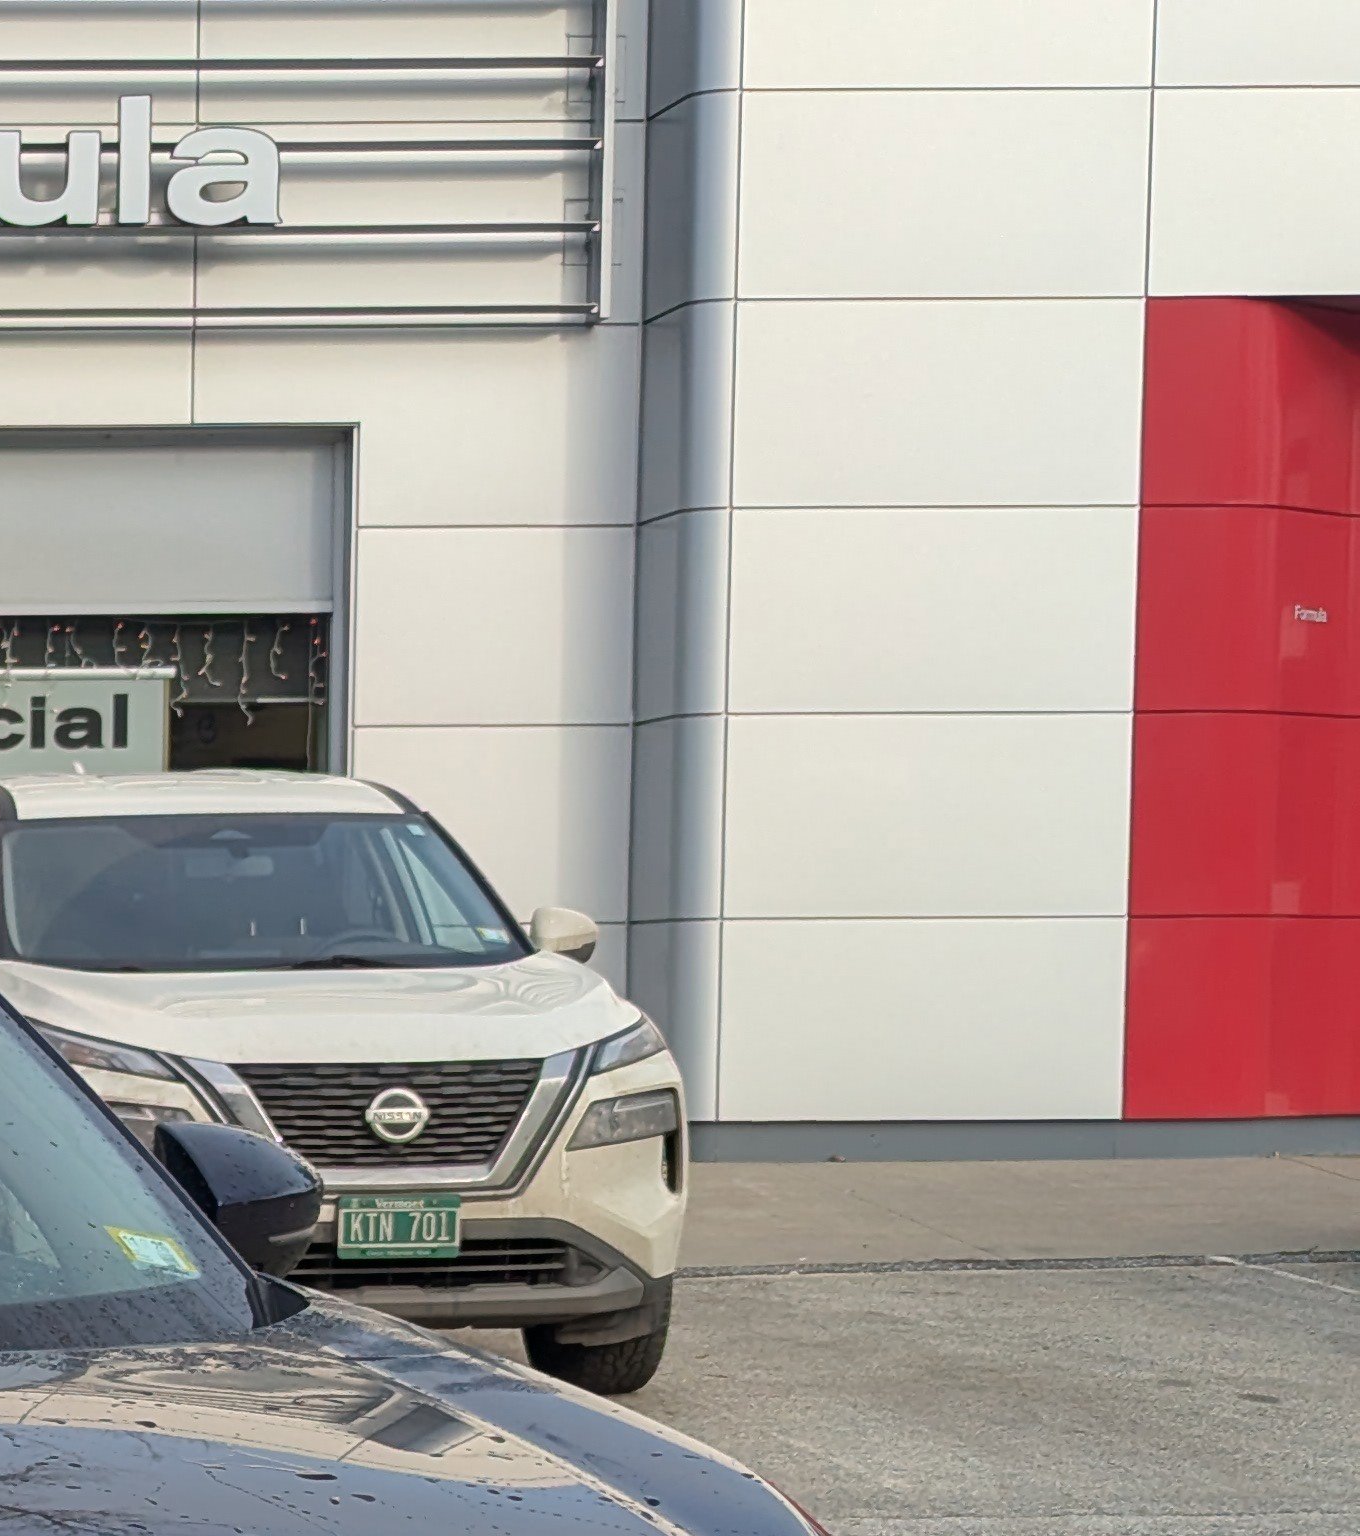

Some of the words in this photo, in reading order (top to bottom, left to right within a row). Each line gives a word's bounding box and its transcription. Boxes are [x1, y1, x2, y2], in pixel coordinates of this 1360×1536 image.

[372, 1111, 423, 1121] NISSAN
[374, 1199, 425, 1209] Vermont
[349, 1211, 394, 1242] KTN
[408, 1211, 450, 1242] 701
